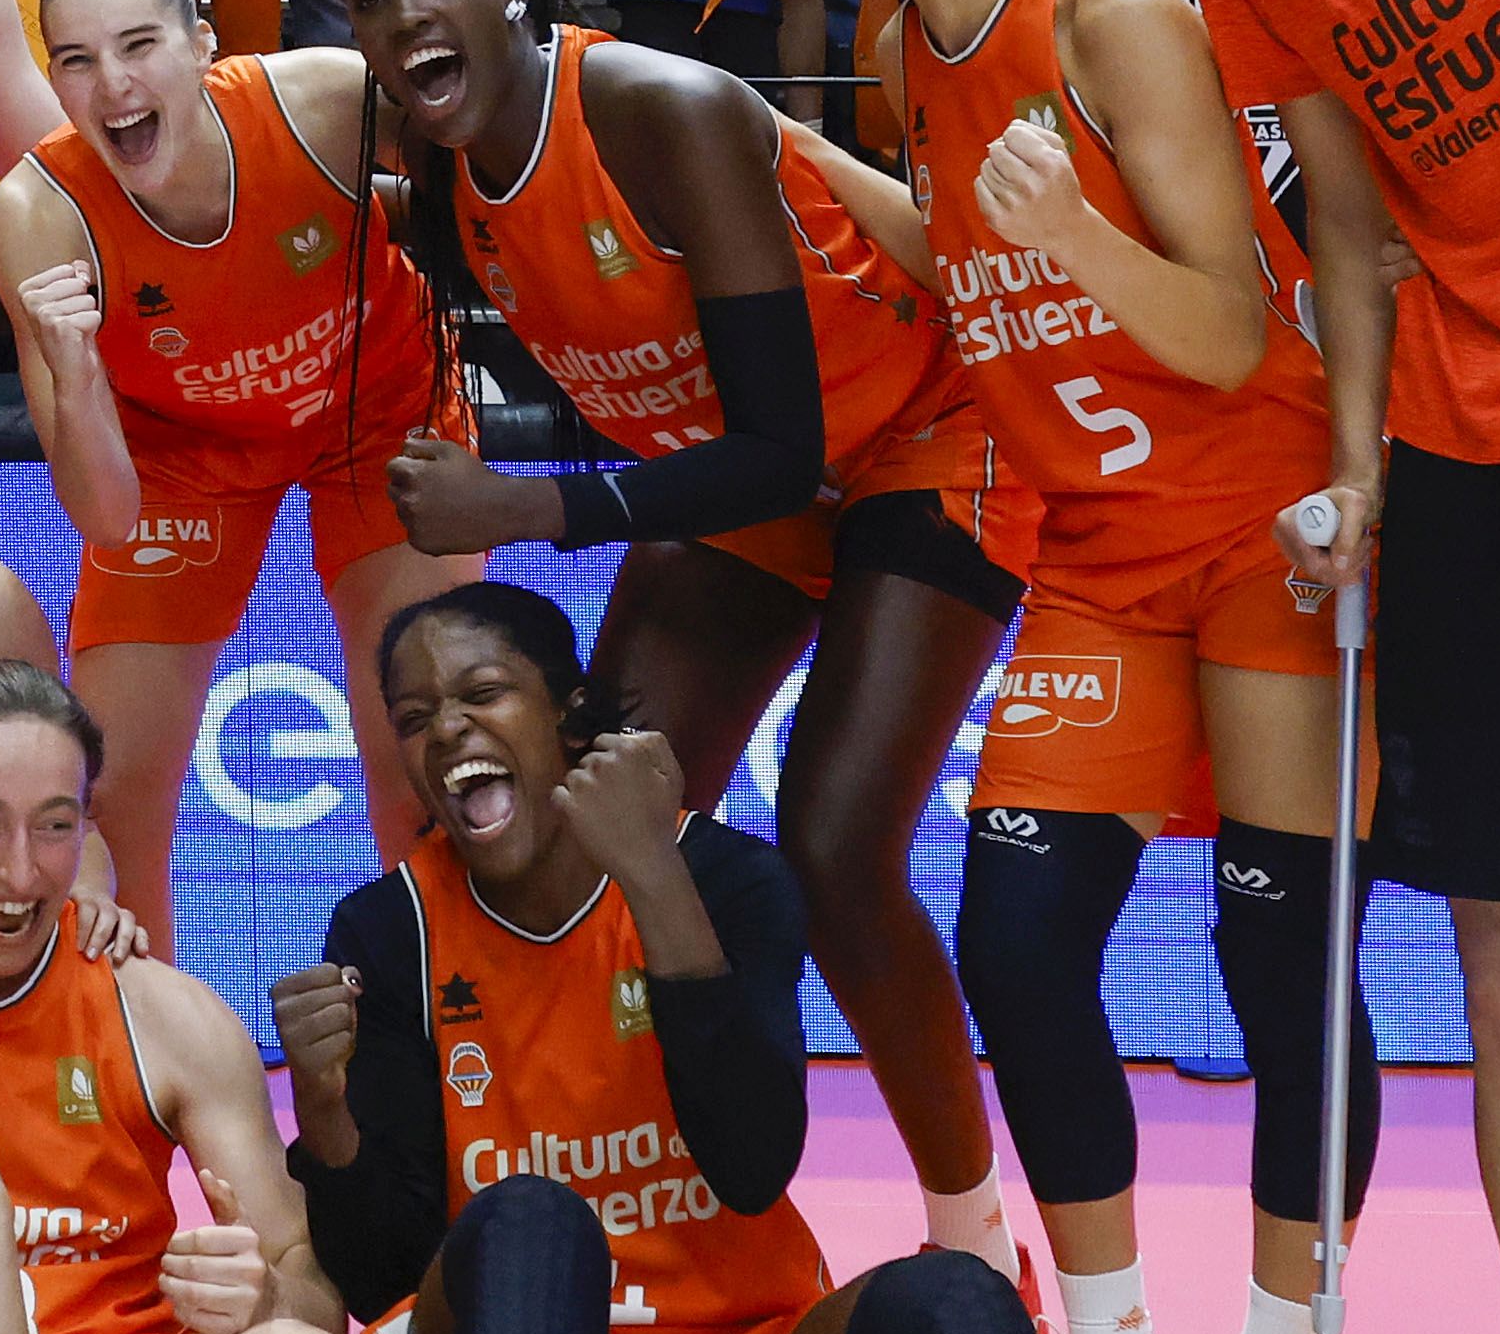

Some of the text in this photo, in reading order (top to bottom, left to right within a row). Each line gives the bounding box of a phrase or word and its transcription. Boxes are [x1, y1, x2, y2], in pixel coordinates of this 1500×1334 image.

[173, 308, 336, 386] Cultura
[672, 331, 702, 359] de
[1052, 375, 1152, 477] 5
[995, 673, 1105, 700] ULEVA
[461, 1122, 663, 1193] Cultura
